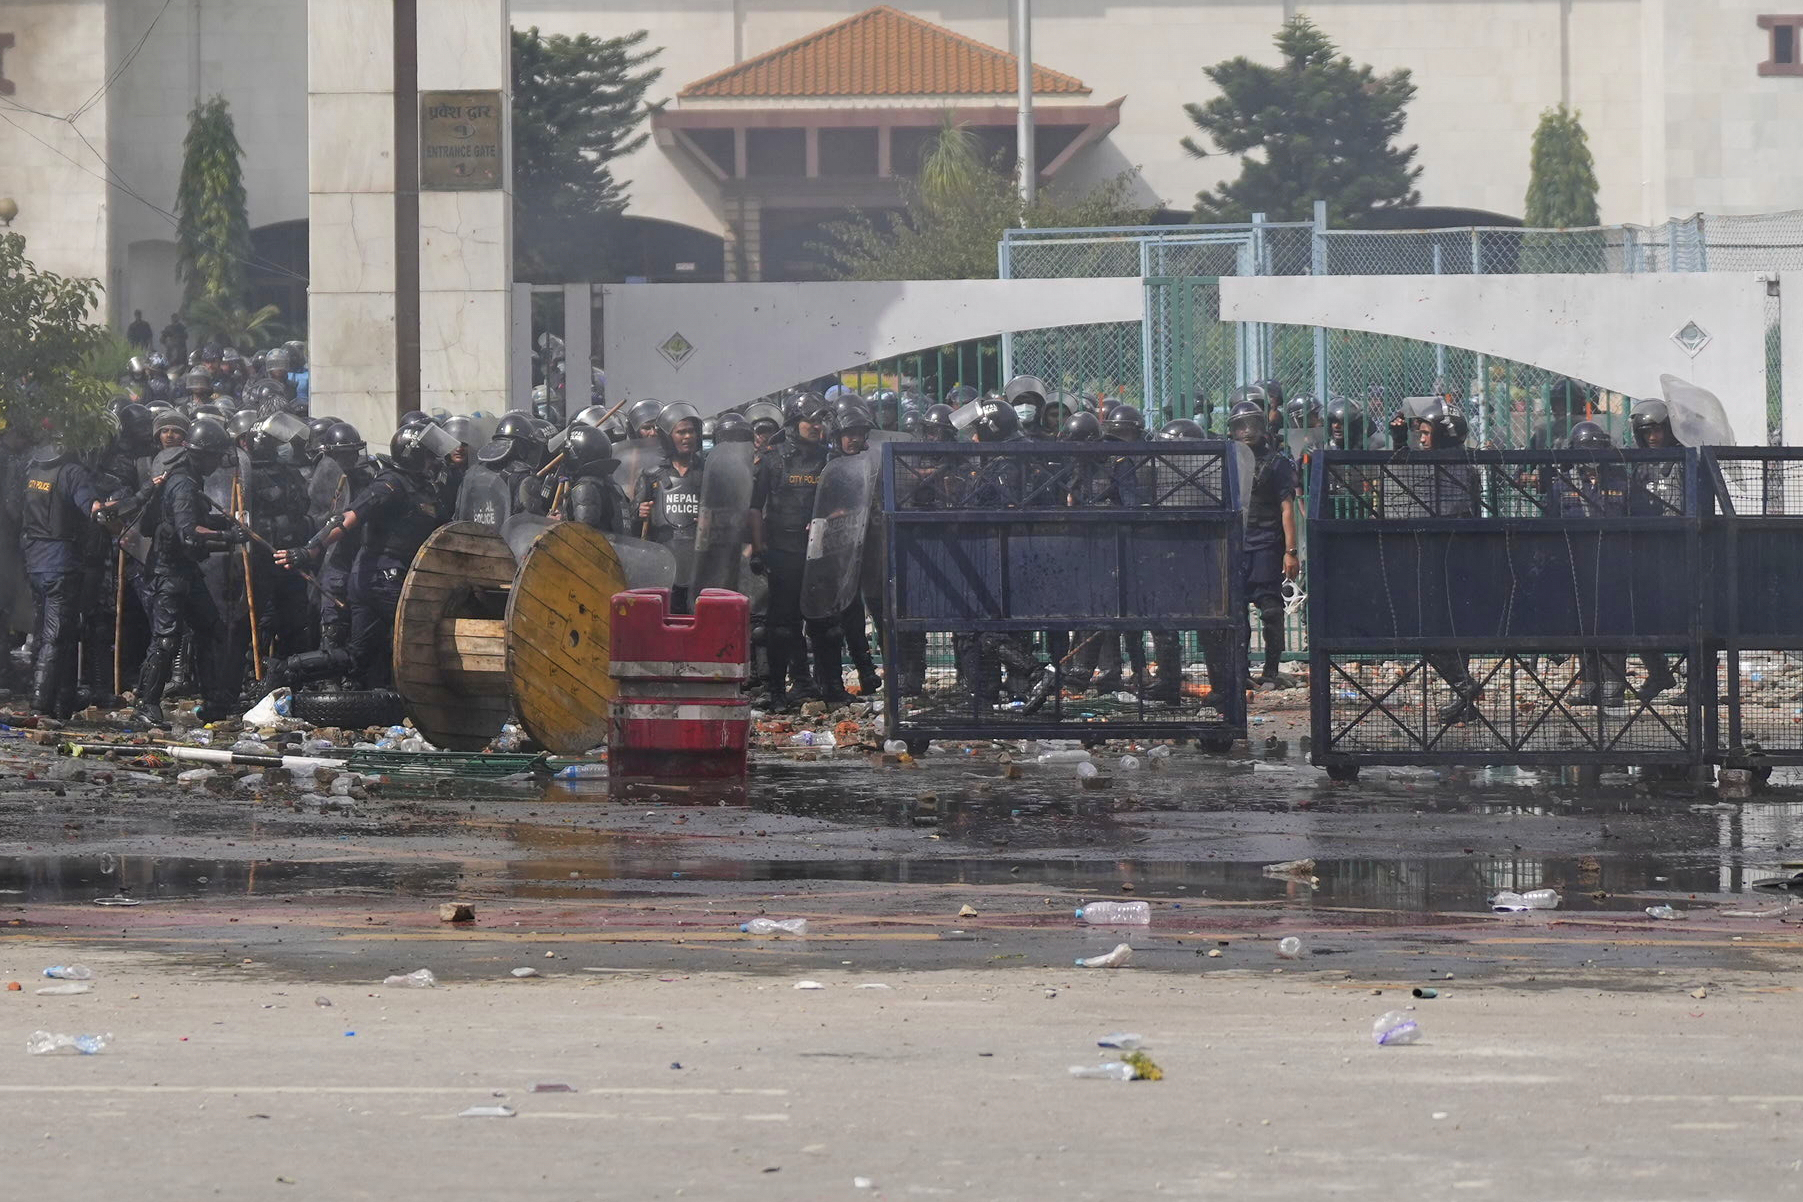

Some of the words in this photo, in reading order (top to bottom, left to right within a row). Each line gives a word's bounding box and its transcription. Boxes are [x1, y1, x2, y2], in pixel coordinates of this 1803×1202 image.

[427, 145, 472, 158] ENTRANCE
[474, 145, 496, 158] GATE
[789, 475, 803, 484] CITY
[666, 493, 699, 503] NEPAL
[666, 504, 698, 514] POLICE
[473, 513, 495, 525] POLICE
